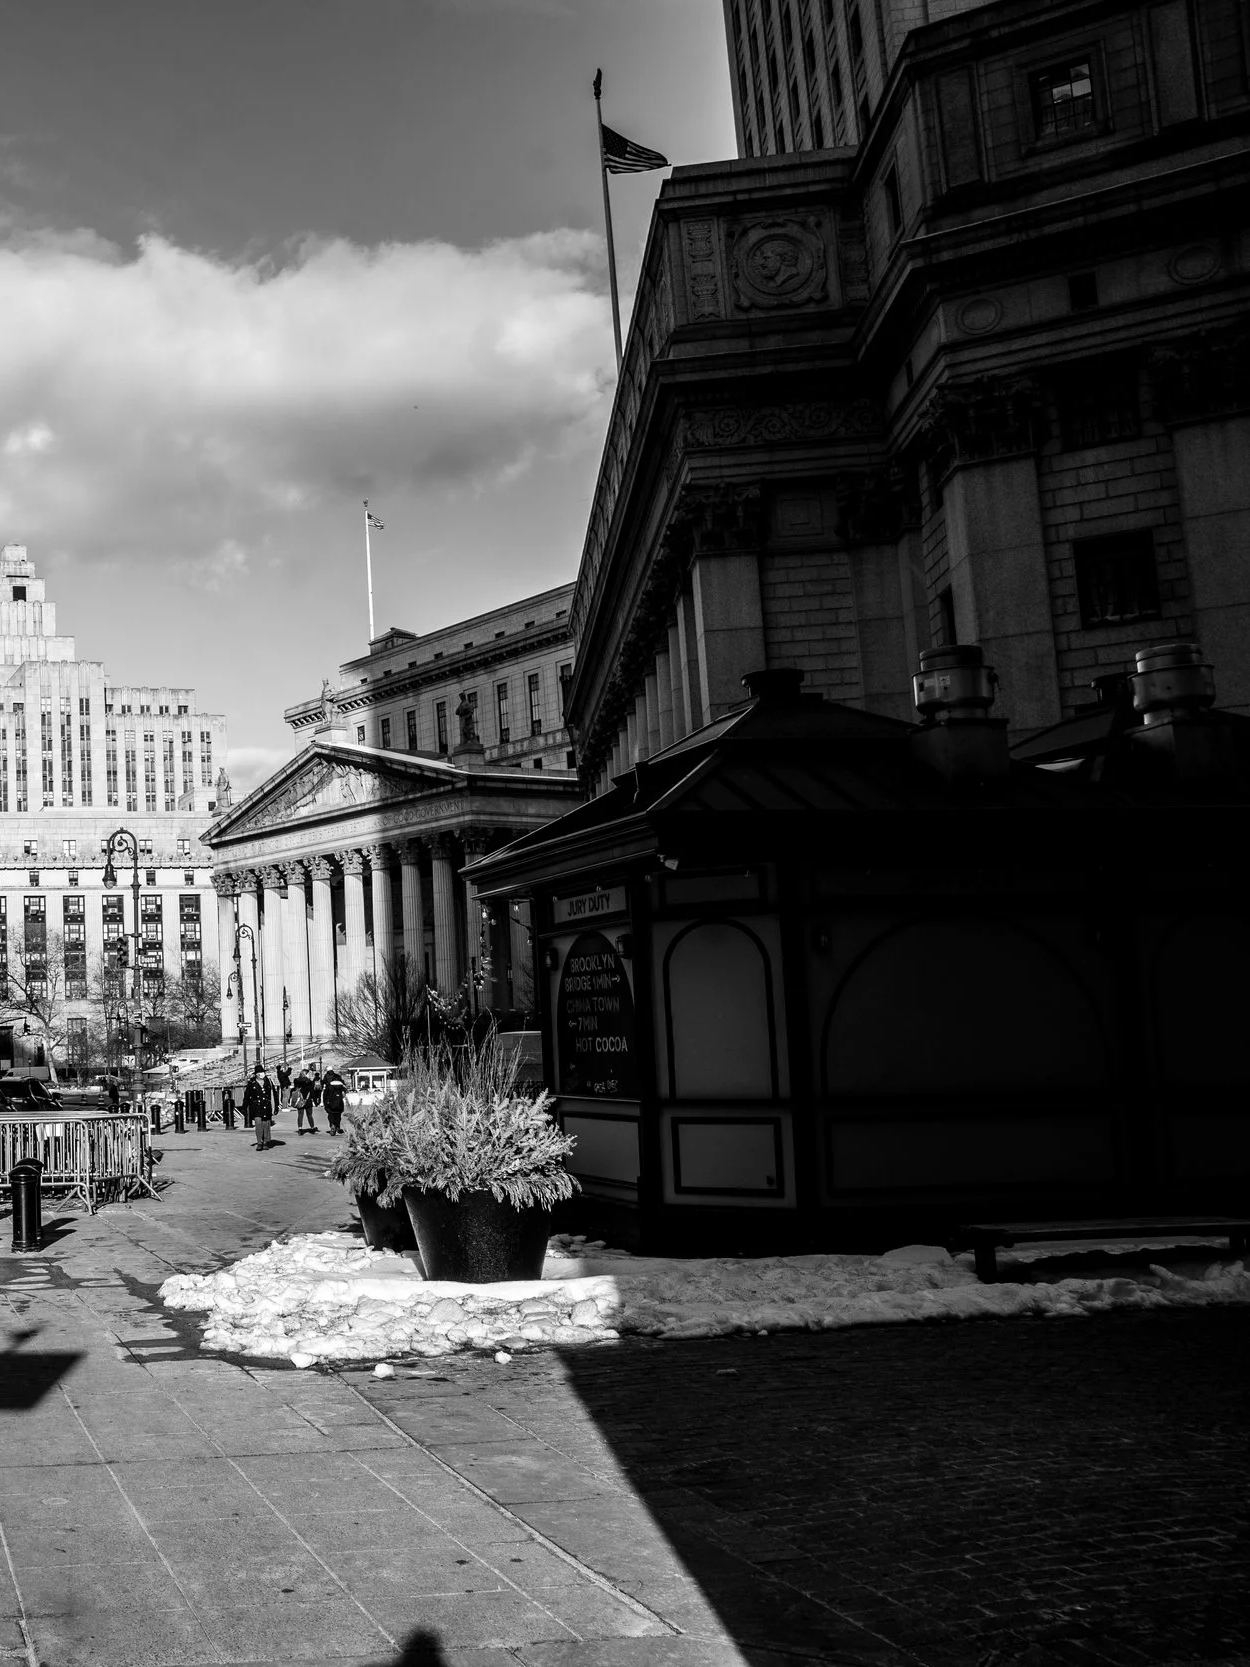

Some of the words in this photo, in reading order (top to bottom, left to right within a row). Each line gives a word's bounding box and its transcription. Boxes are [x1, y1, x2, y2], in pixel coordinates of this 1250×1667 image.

[567, 898, 587, 917] JURY
[588, 893, 610, 913] DUTY
[570, 953, 615, 973] BROOKLYN
[564, 975, 592, 992] BRIDGE
[566, 997, 591, 1014] CHINA
[592, 995, 620, 1013] TOWN
[575, 1036, 593, 1053] HOT
[595, 1036, 628, 1053] COCOA
